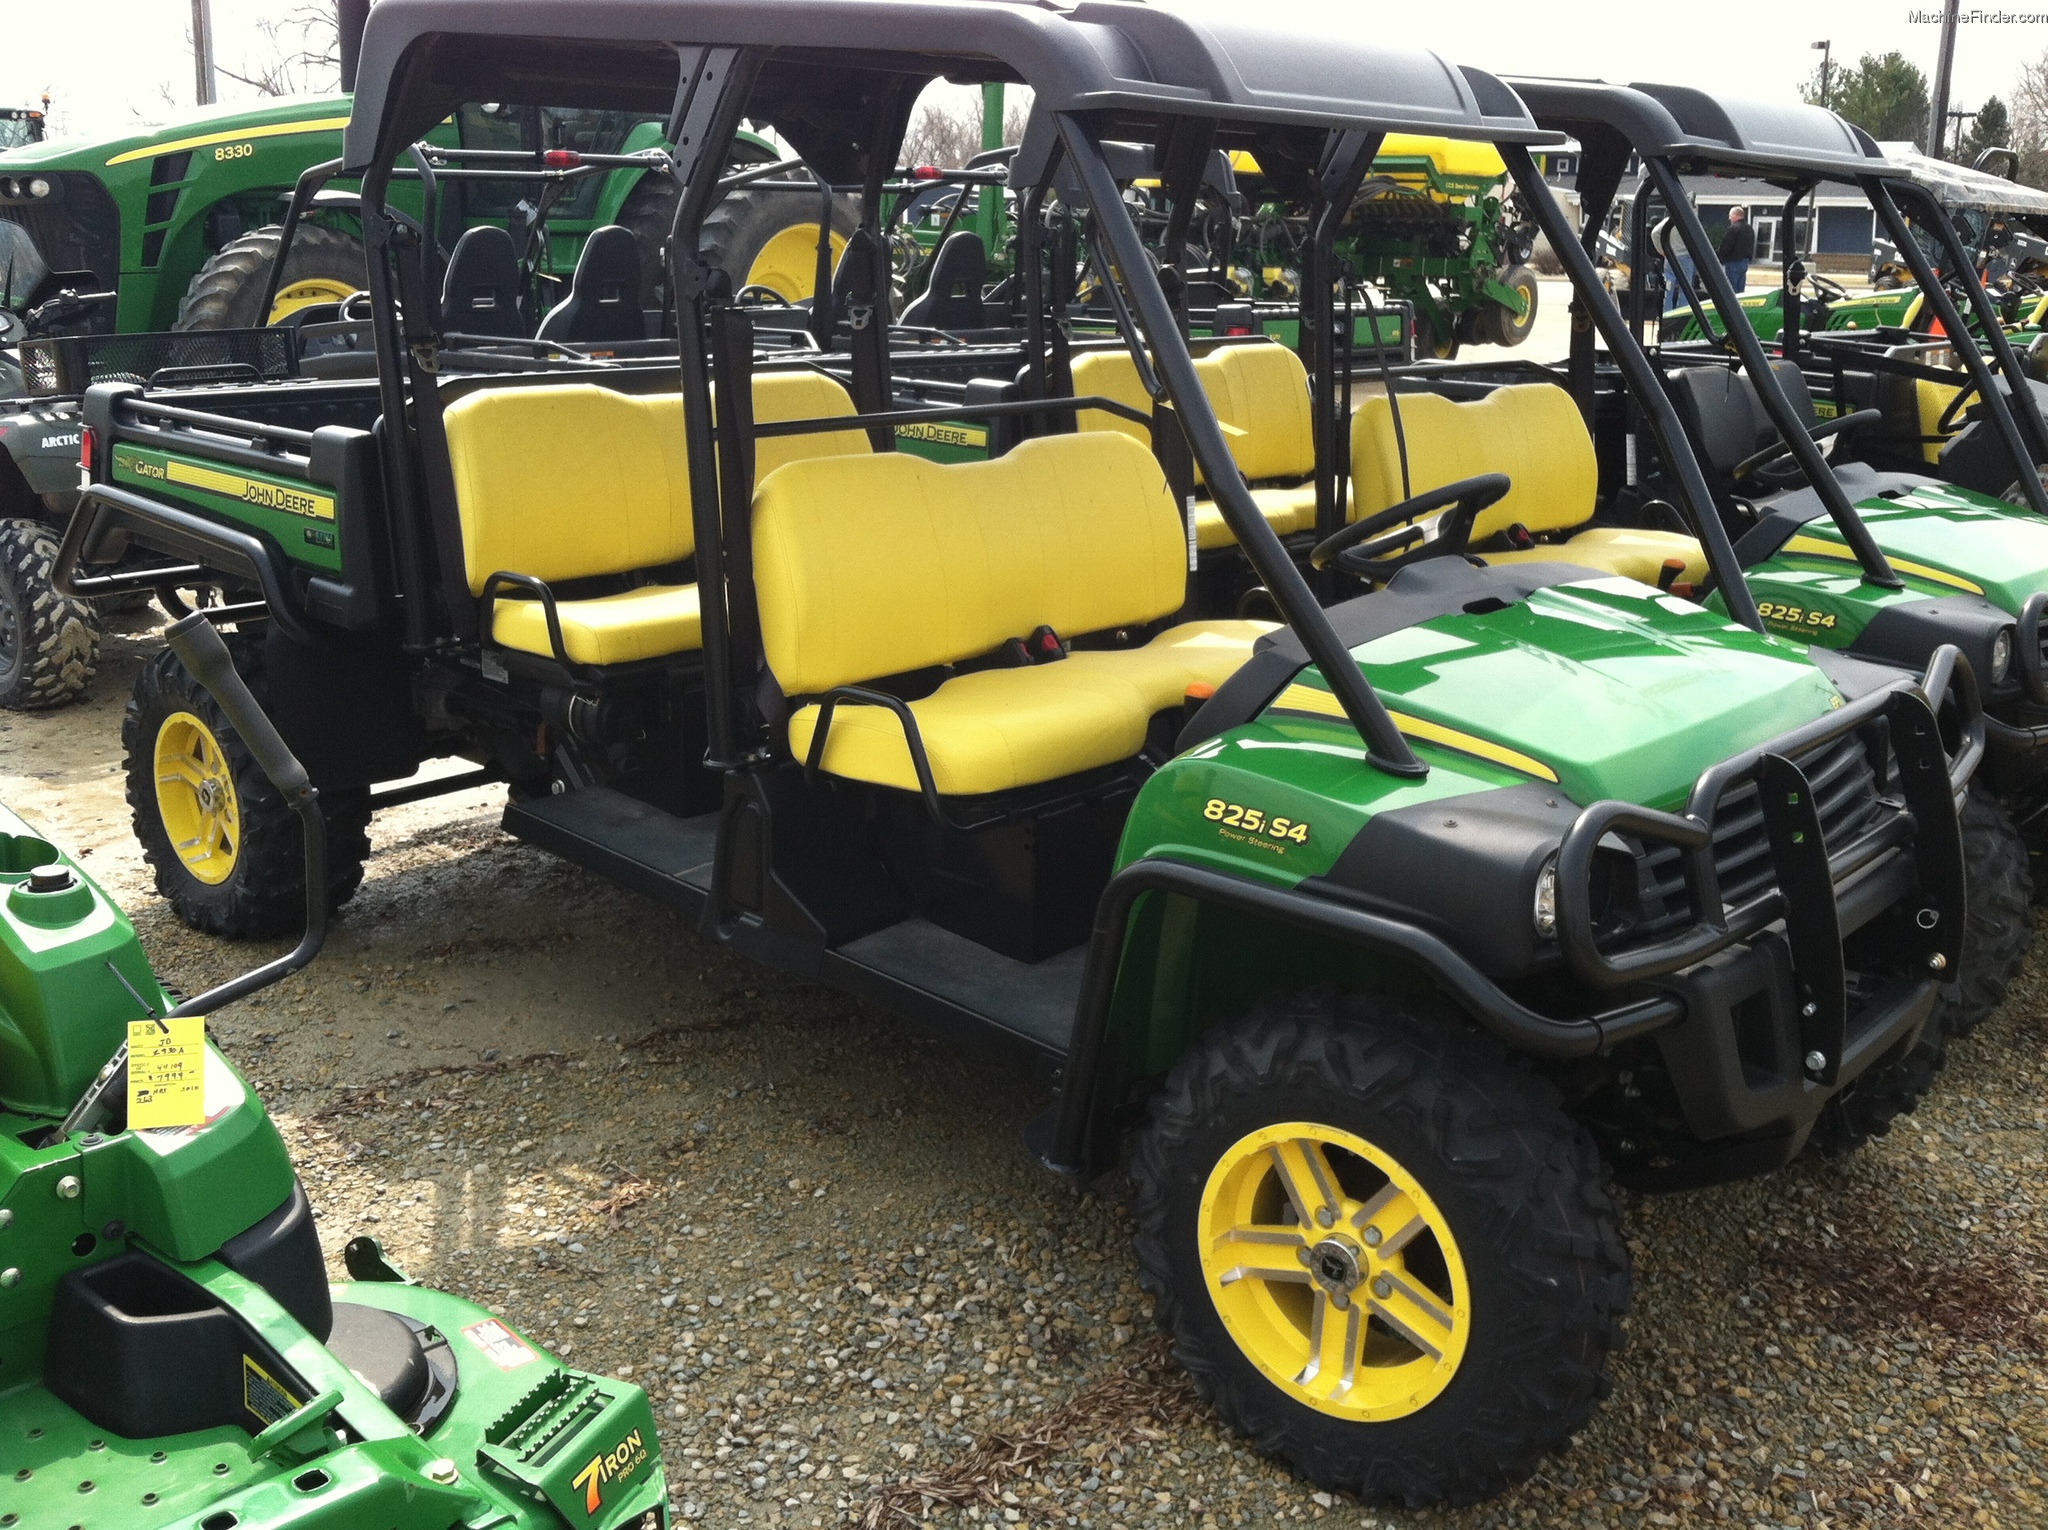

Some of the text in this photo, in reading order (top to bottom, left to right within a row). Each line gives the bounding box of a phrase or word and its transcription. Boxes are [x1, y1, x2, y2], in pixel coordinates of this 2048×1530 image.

[215, 144, 253, 161] 8330
[41, 433, 80, 448] ARCTIC
[926, 425, 967, 444] DEERE
[242, 481, 316, 515] JOHN DEERE
[1757, 602, 1836, 628] 825i S4
[1203, 799, 1308, 843] 825i S4
[1219, 828, 1285, 855] Power Steering
[617, 1461, 635, 1483] PRO
